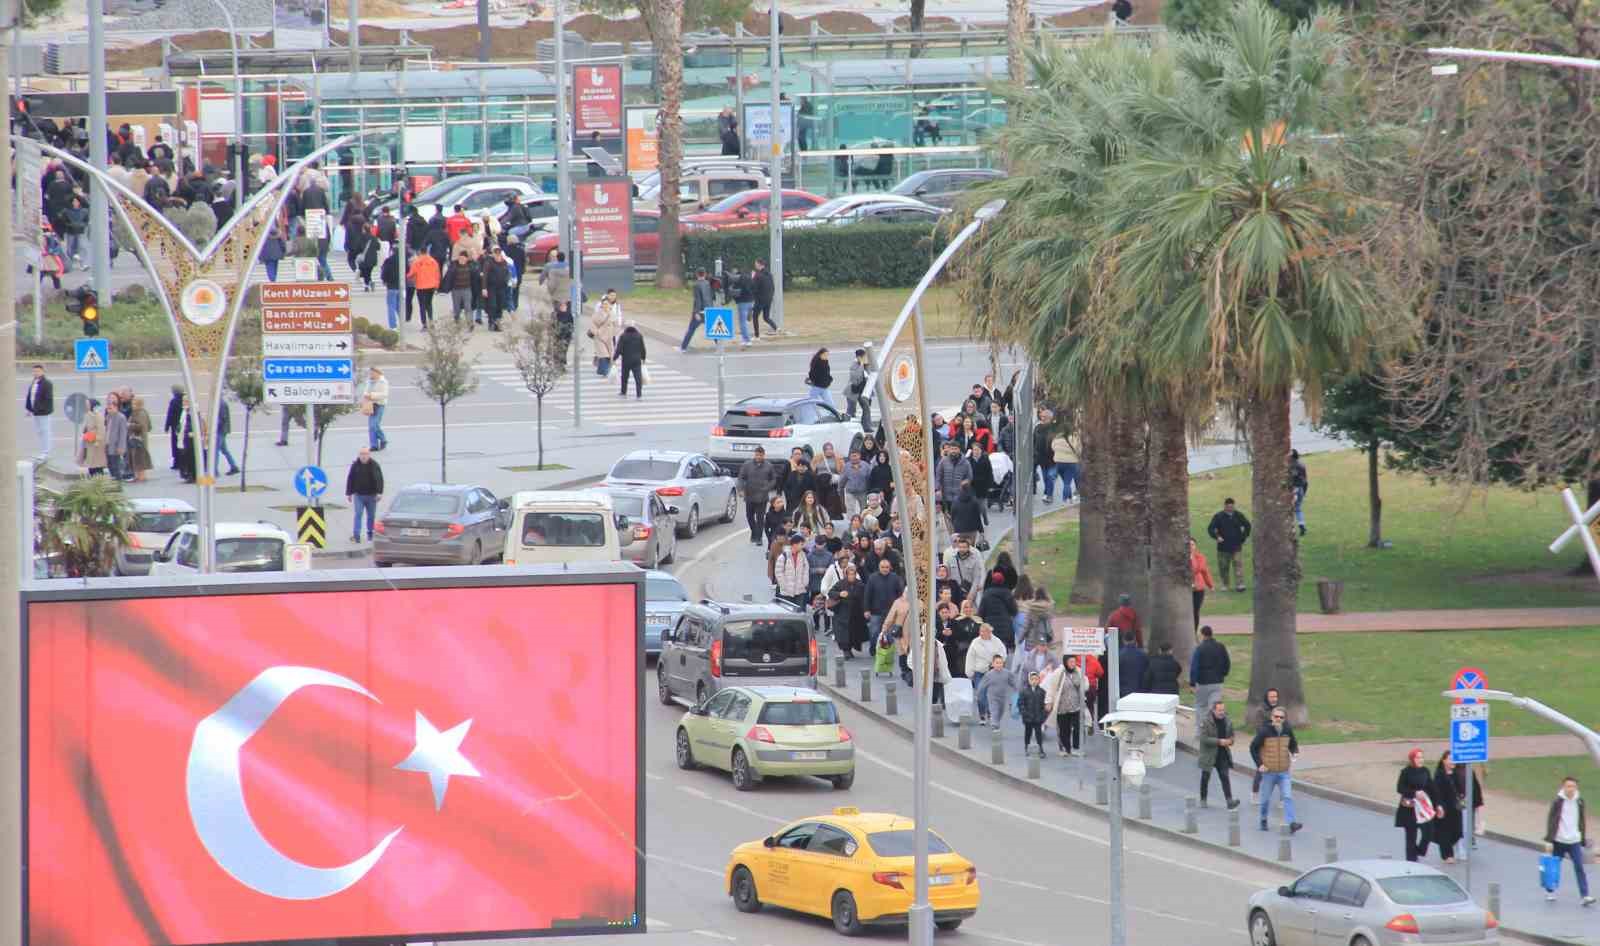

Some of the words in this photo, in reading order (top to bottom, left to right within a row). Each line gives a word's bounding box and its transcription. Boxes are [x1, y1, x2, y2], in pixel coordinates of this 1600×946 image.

[263, 288, 289, 298] Kent
[266, 310, 321, 318] Bandırma
[267, 363, 333, 375] Çarşamba
